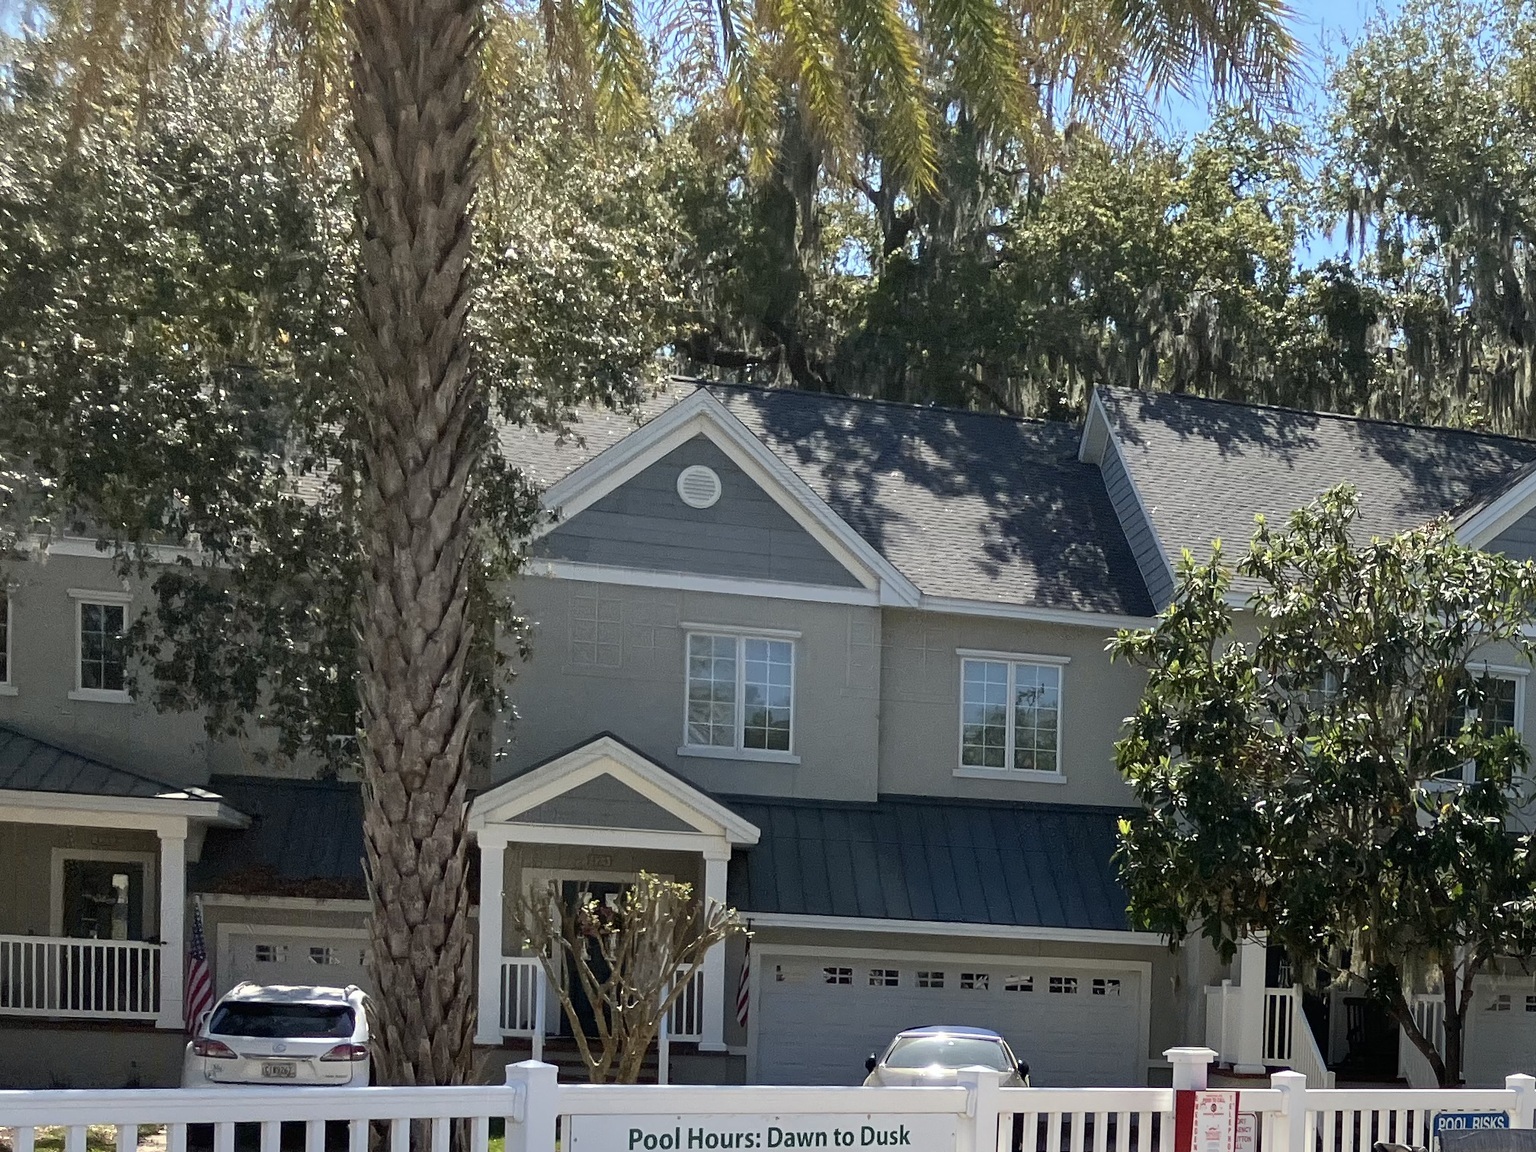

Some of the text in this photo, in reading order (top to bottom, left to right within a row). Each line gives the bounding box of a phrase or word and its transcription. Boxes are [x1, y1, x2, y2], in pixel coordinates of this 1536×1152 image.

[629, 1124, 911, 1150] Pool Hours: Dawn to Dusk
